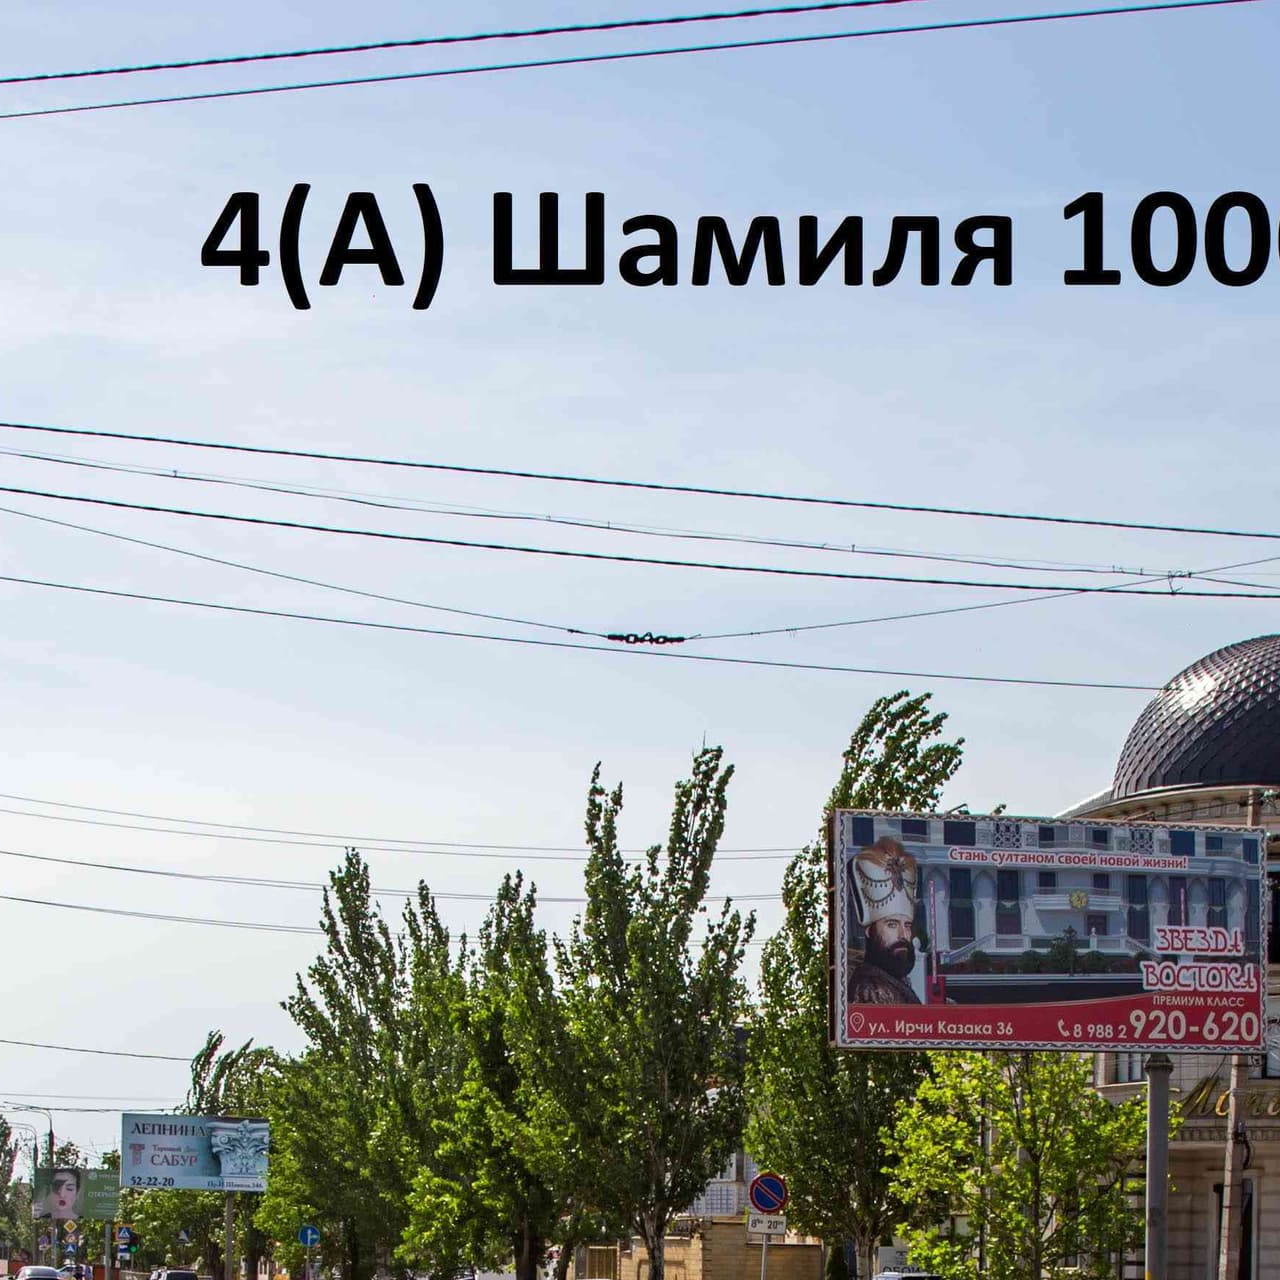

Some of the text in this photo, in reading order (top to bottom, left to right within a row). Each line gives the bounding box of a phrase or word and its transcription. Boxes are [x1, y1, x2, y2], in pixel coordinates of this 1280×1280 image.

[949, 848, 1187, 869] Стань султаном своей новой жизни!
[1156, 928, 1242, 953] ЗВЕЗДА
[1143, 963, 1255, 988] ВОСТОКА
[1153, 995, 1245, 1007] ПРЕМИУМ КЛАСС
[869, 1020, 1013, 1036] ул. Ирчи Казака 36
[1073, 1024, 1082, 1037] 8
[1087, 1024, 1114, 1038] 988
[1129, 1009, 1259, 1041] 920-620
[131, 1122, 207, 1137] ЛЕПНИНА
[151, 1154, 198, 1167] САБУР
